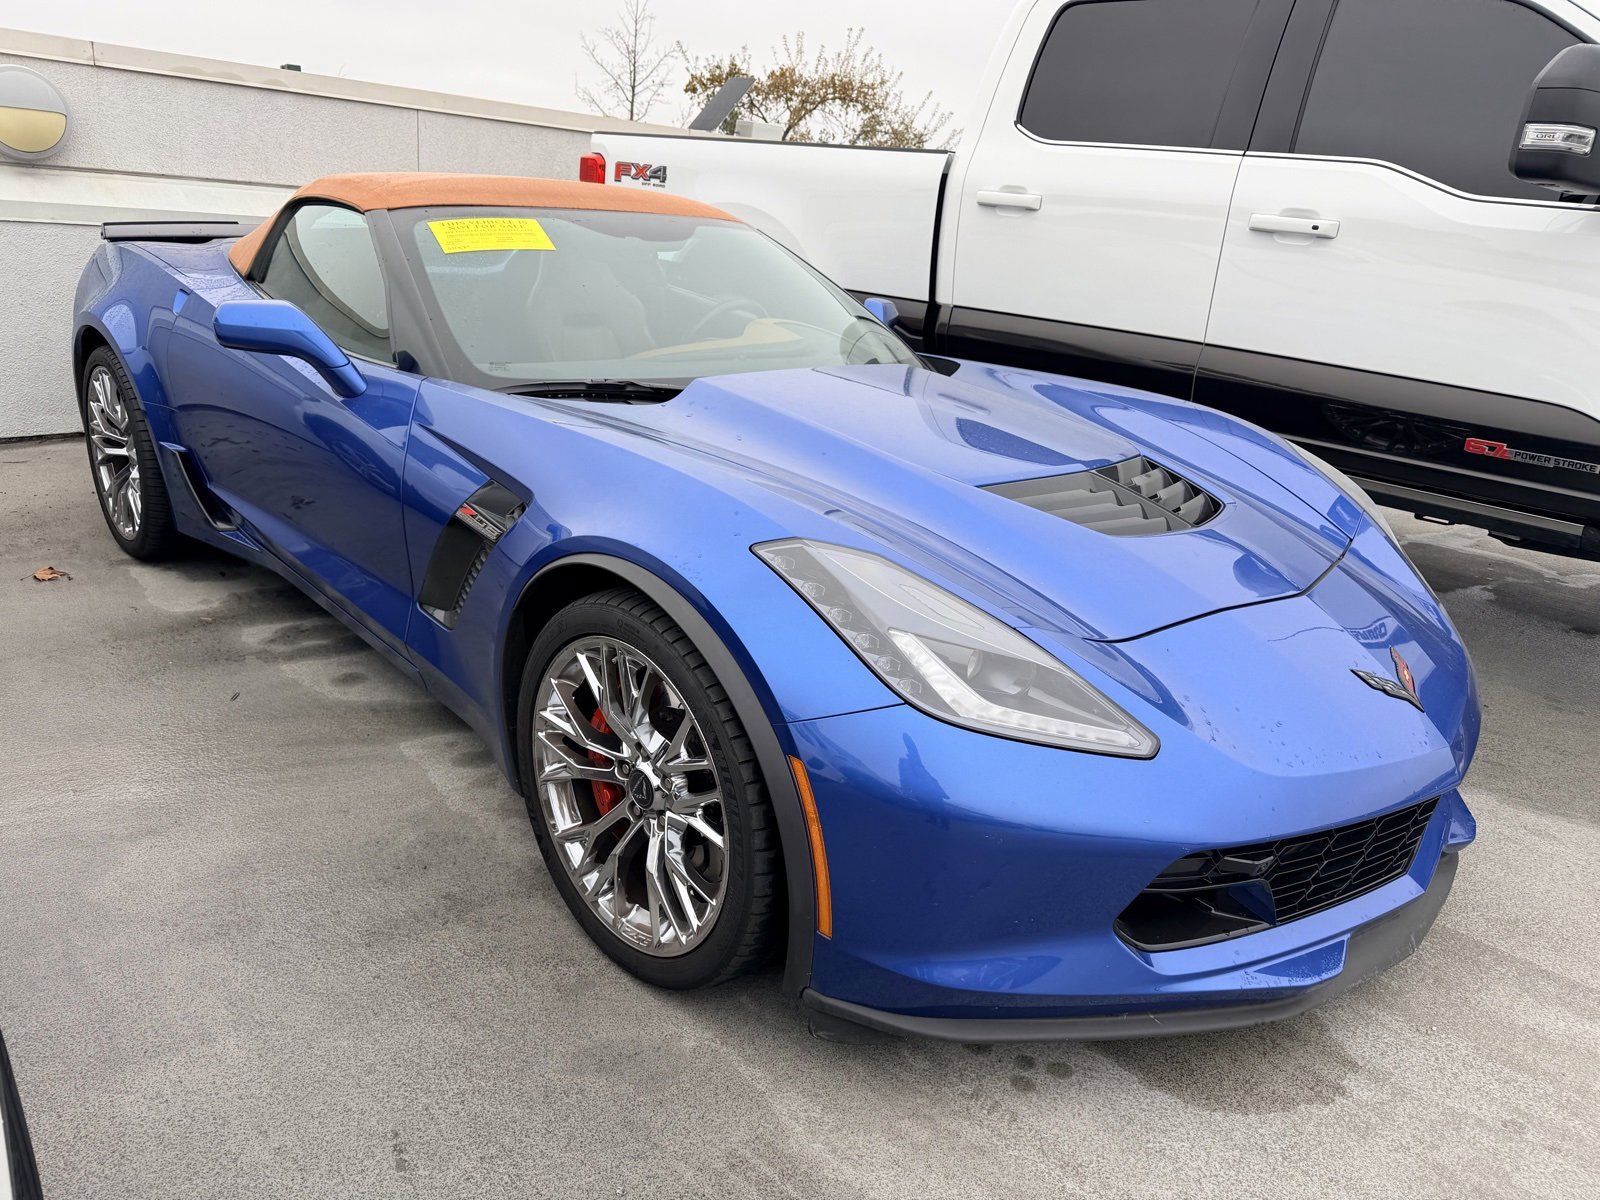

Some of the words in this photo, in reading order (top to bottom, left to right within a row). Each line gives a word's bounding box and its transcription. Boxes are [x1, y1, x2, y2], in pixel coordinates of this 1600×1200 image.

[614, 161, 667, 183] FX4
[1514, 450, 1551, 465] POWER
[1553, 457, 1597, 473] STROKE
